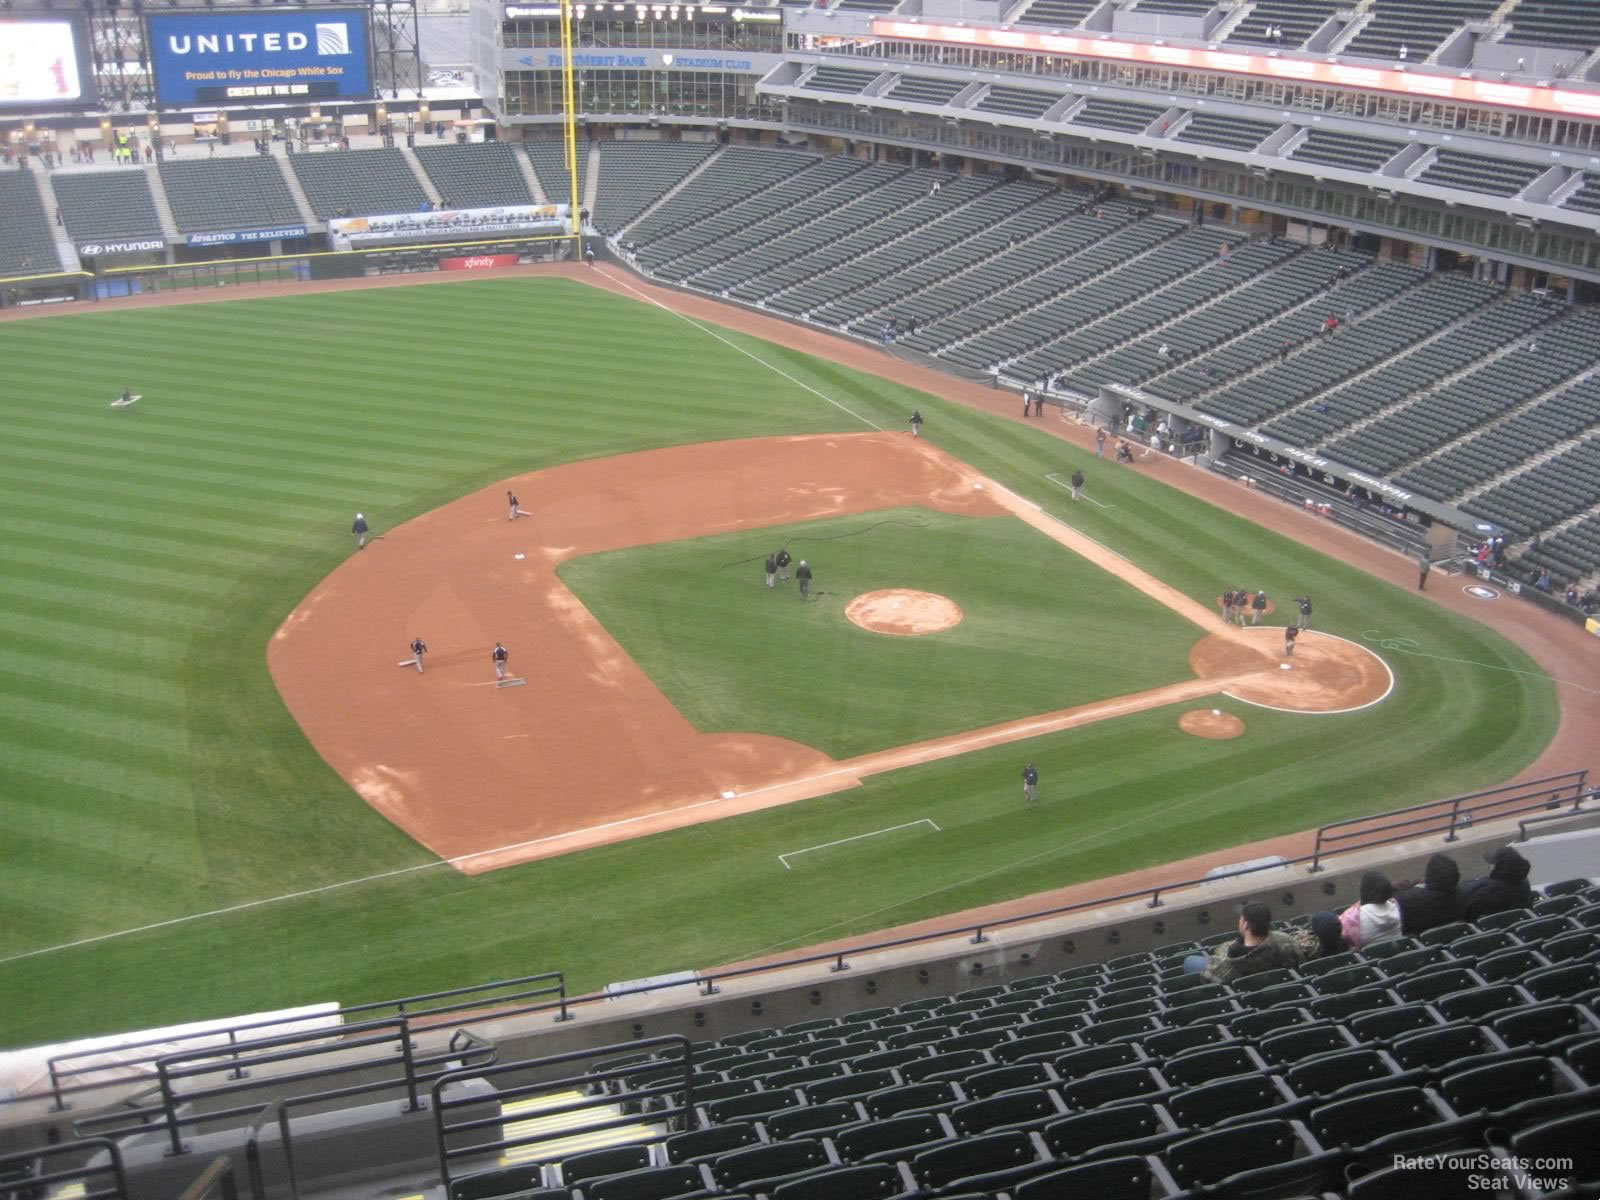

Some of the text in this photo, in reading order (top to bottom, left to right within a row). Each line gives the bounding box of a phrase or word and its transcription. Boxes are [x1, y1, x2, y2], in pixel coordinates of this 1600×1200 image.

[169, 32, 308, 54] UNITED
[676, 57, 753, 70] STADIUM CLUB
[186, 66, 343, 80] Proud to fly the Chicago White Sox
[227, 84, 309, 97] CHECK OUT THE SOX
[241, 228, 304, 241] THE RELIEVERS
[106, 241, 164, 253] HYUNDAI
[464, 256, 495, 268] xfinity
[1347, 472, 1412, 500] Welcome
